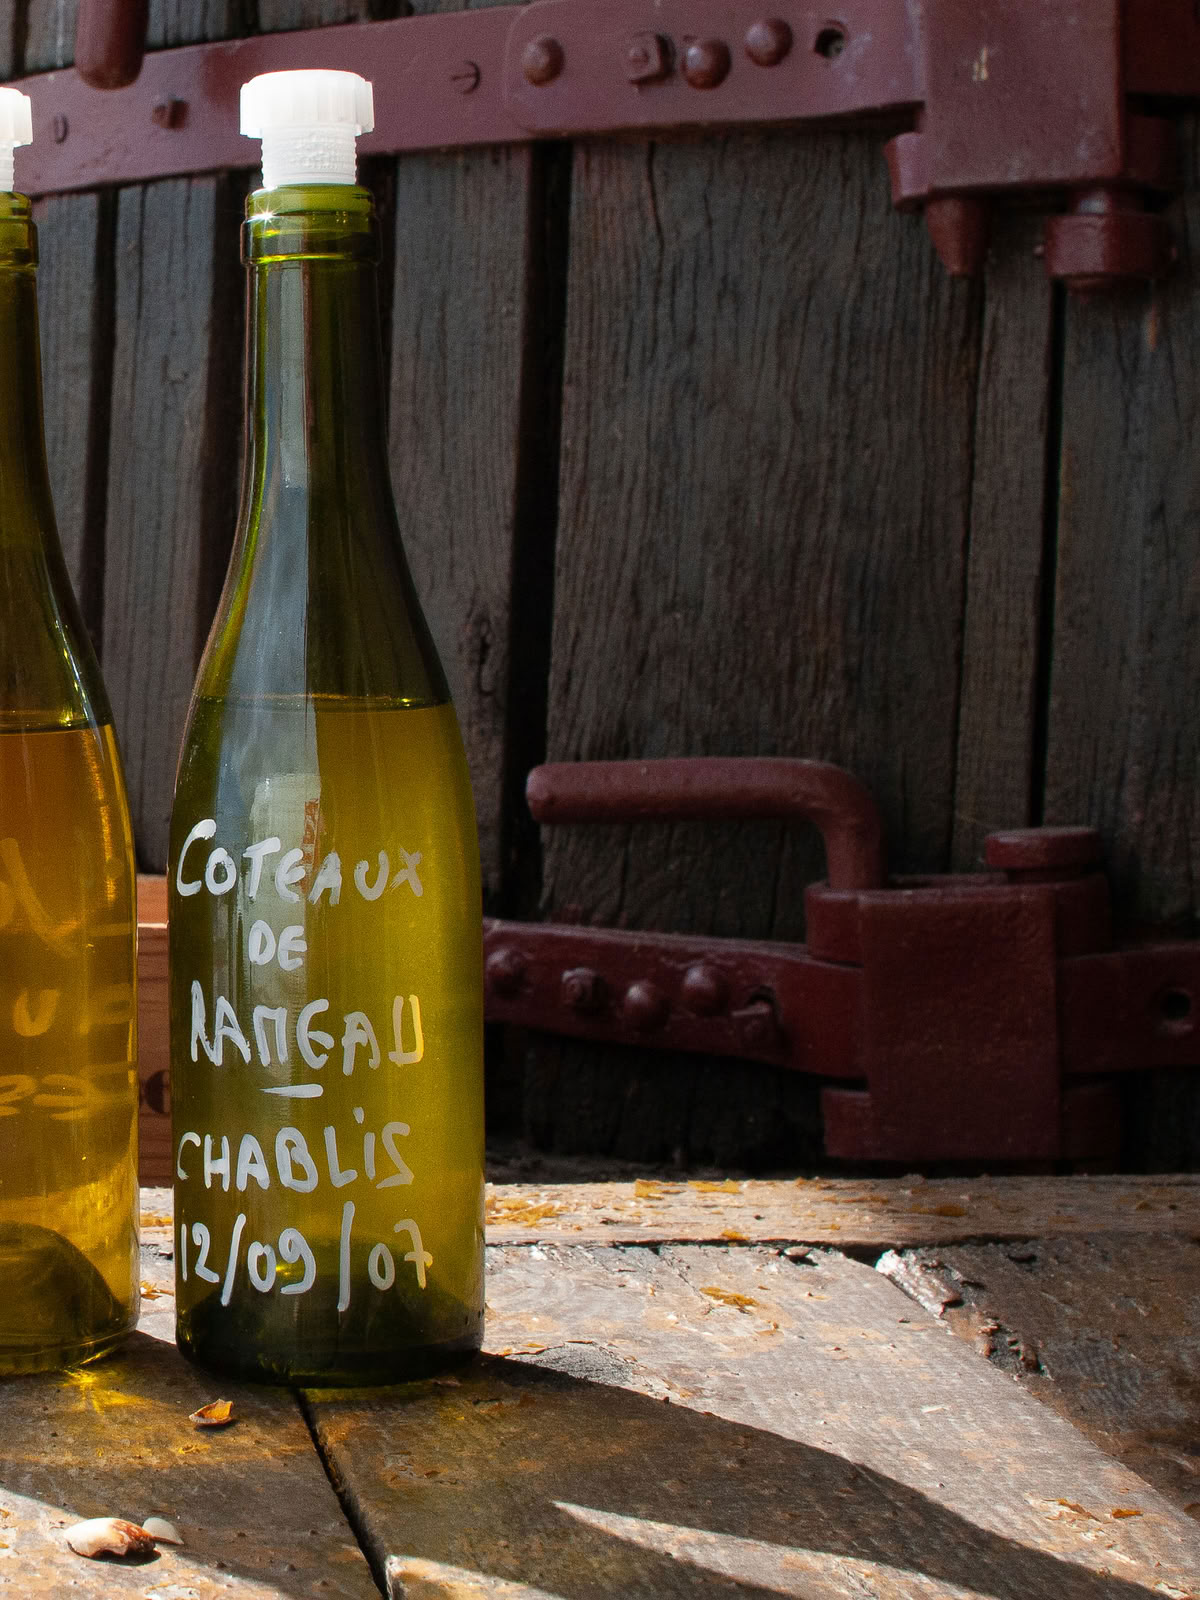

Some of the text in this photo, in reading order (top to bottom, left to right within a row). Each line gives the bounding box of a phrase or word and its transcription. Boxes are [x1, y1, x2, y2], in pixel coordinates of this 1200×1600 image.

[176, 819, 424, 906] COTEAUX
[248, 919, 308, 971] DE
[181, 1200, 433, 1313] 12/09/07
